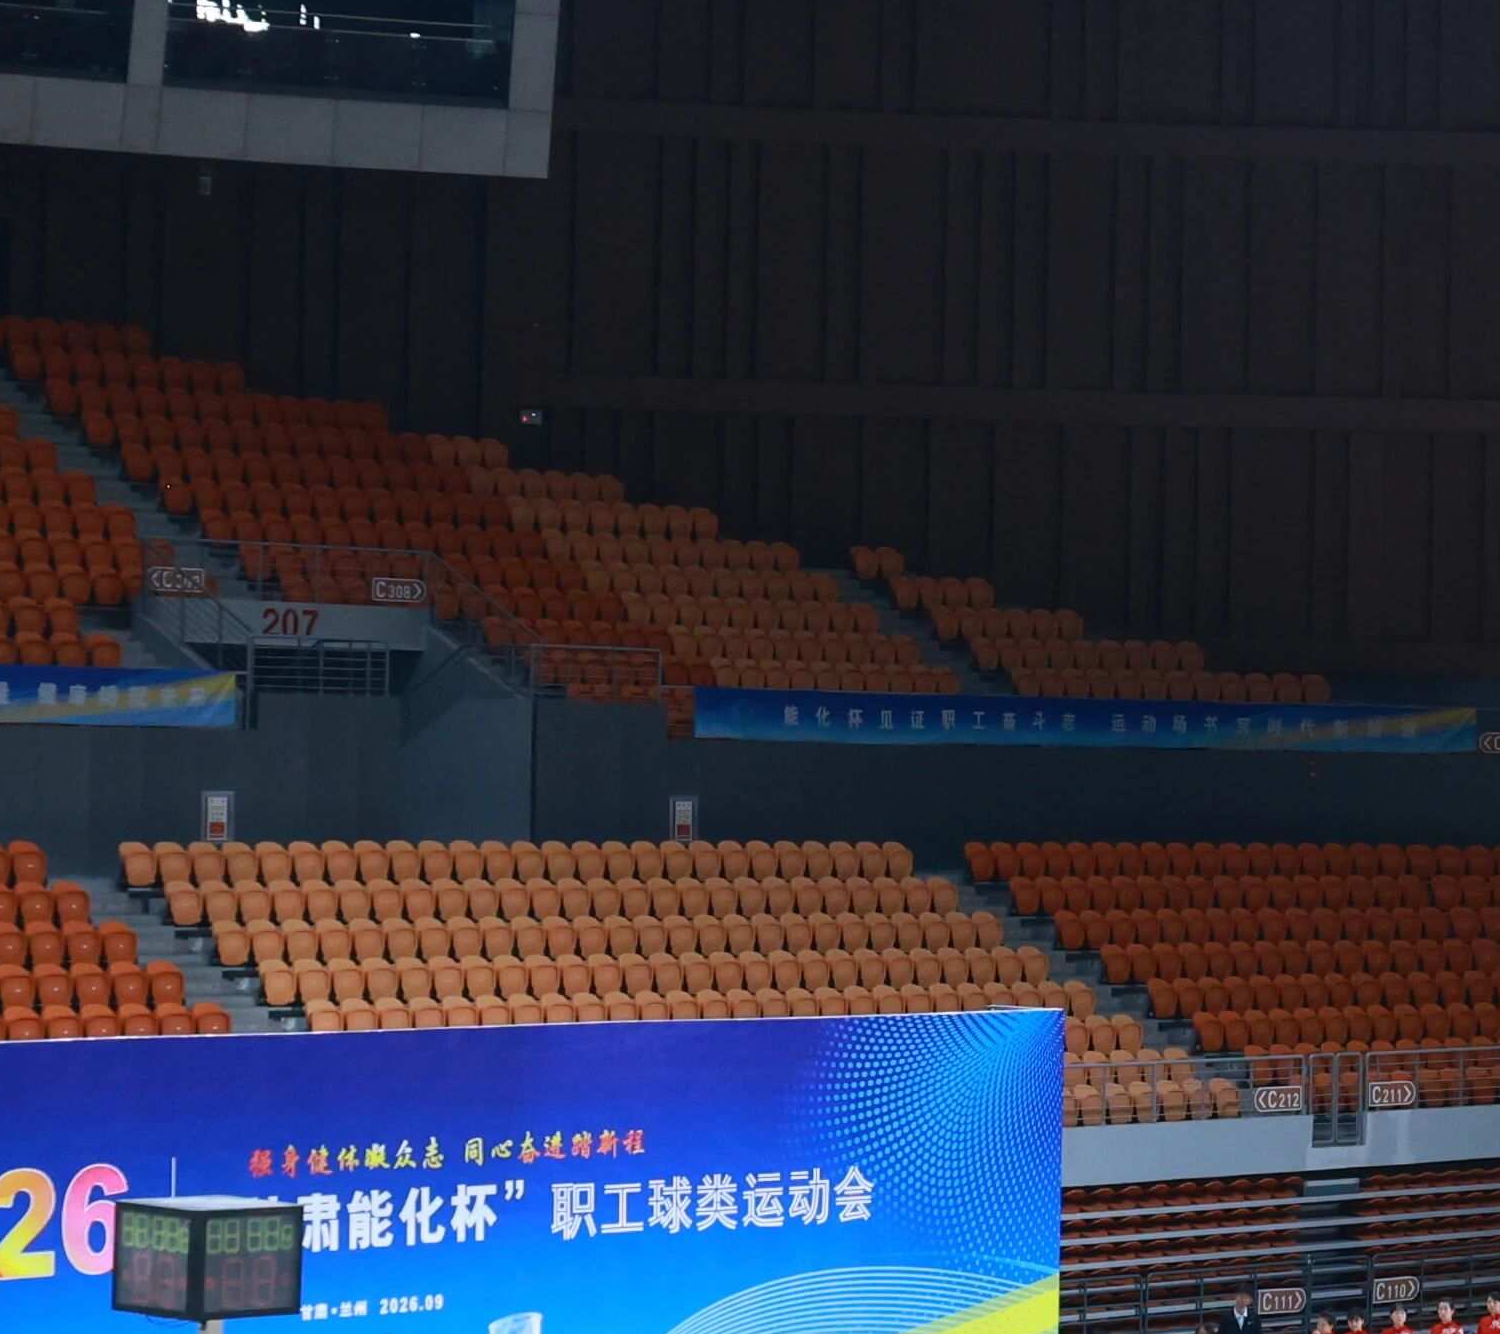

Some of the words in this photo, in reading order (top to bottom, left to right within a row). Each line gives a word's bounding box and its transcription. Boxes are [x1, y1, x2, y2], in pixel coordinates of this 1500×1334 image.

[375, 579, 413, 599] C308
[263, 609, 319, 638] 207
[248, 1136, 445, 1178] 强身健体凝众志
[256, 1178, 526, 1254] 肃能化杯”
[550, 1165, 875, 1242] 职工球类运动会
[379, 1293, 446, 1316] 2026.09
